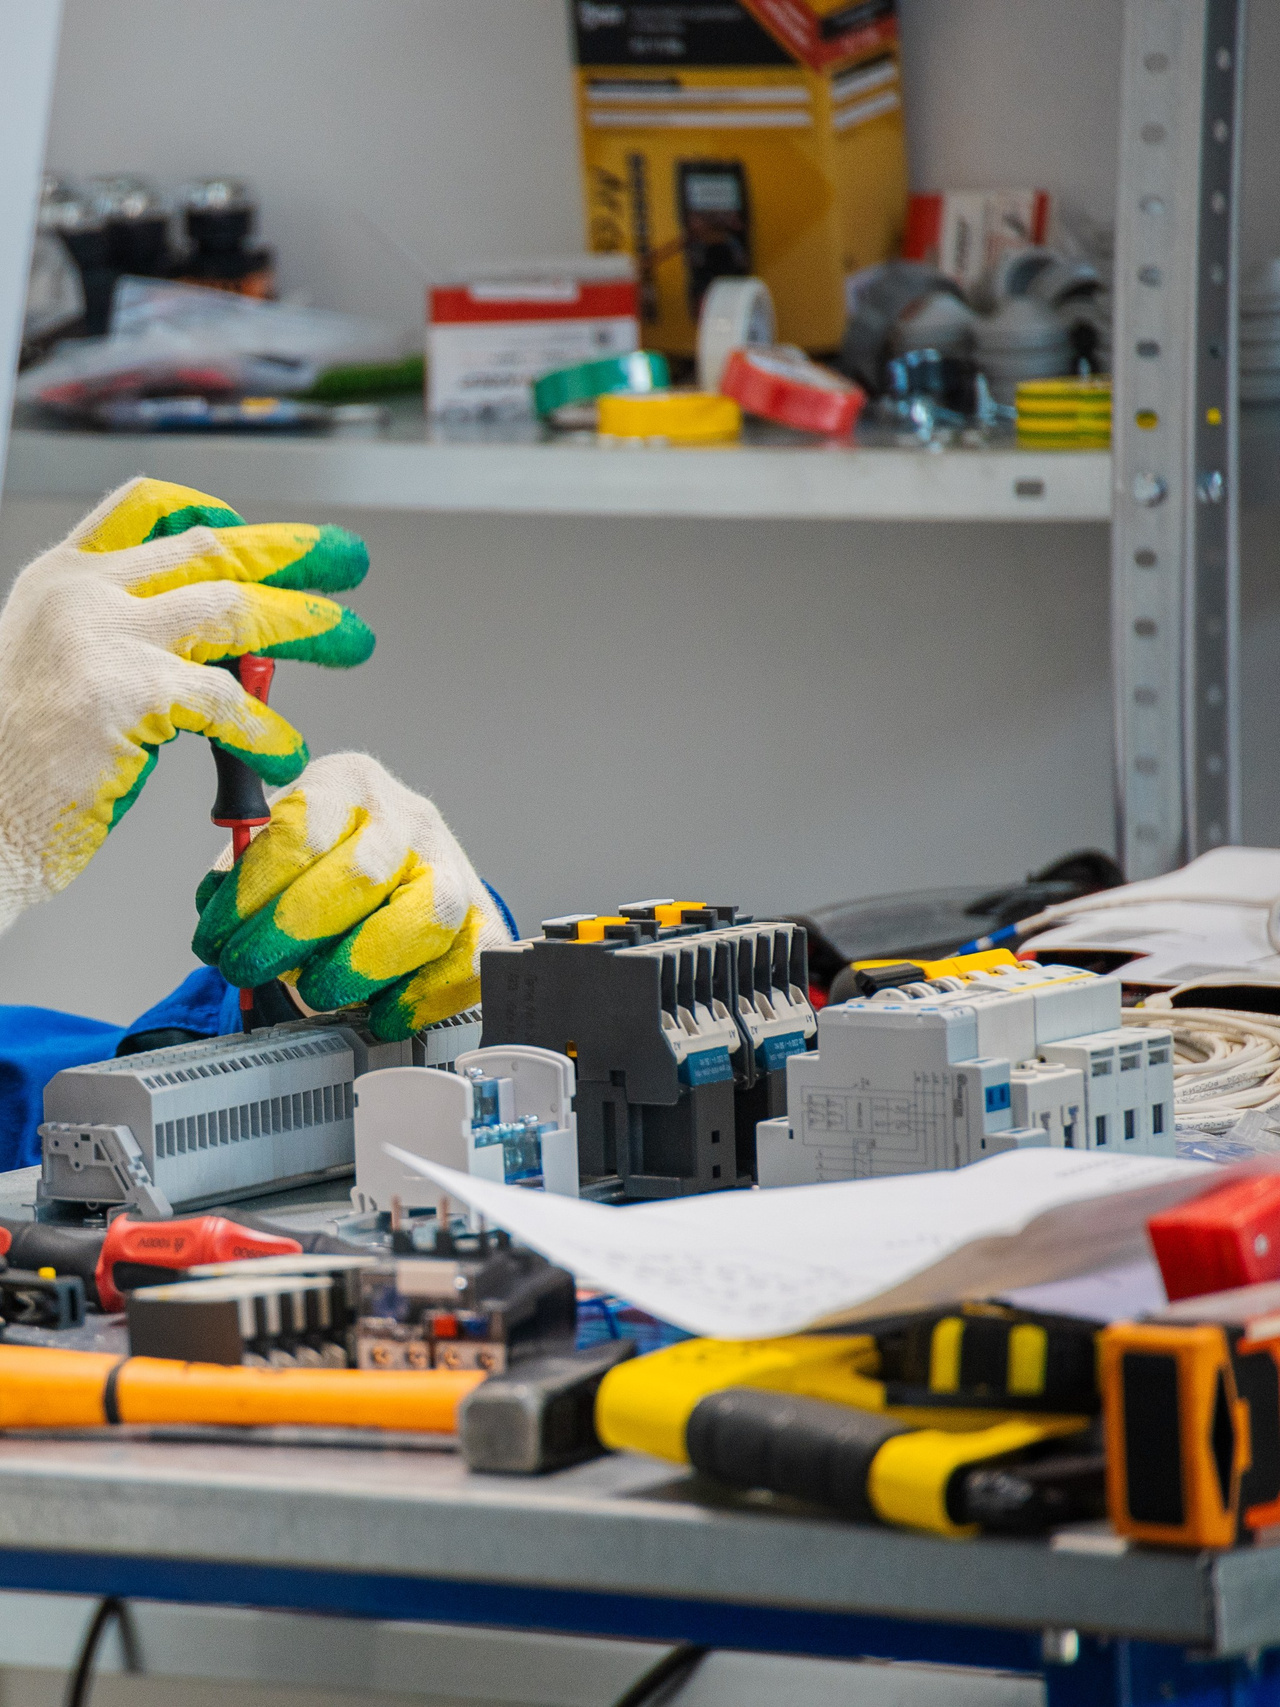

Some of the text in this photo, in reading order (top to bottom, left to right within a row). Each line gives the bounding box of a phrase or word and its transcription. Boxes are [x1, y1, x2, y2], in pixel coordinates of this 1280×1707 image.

[805, 1014, 813, 1023] A1
[729, 1030, 736, 1039] A1
[750, 1025, 758, 1035] A2
[673, 1042, 681, 1051] A2
